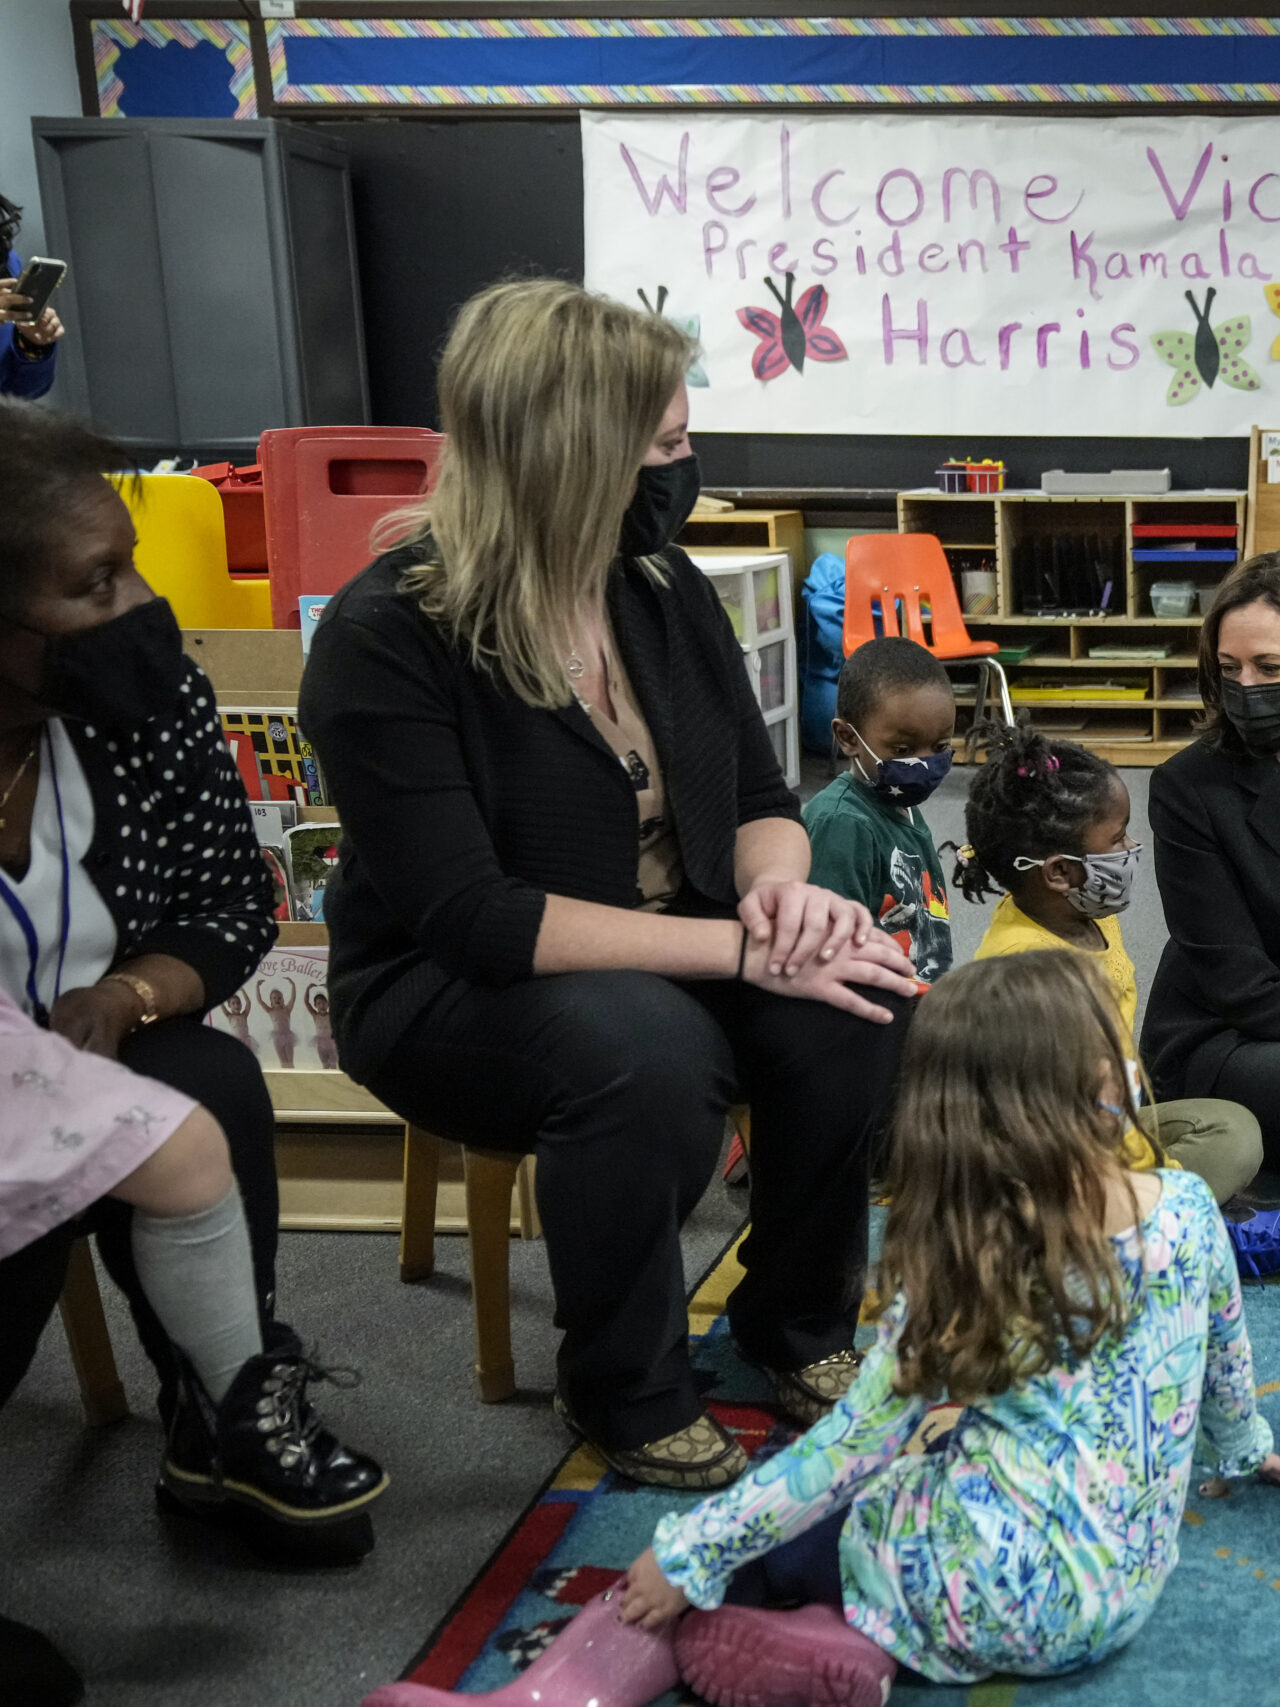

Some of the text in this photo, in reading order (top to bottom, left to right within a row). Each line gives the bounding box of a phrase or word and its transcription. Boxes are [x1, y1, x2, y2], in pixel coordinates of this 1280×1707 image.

[620, 126, 1085, 227] Welcome
[702, 220, 1272, 300] President Kamala
[881, 293, 1140, 370] Harris
[1269, 437, 1280, 446] My
[254, 808, 267, 816] 103
[259, 958, 327, 981] ove Ballet!
